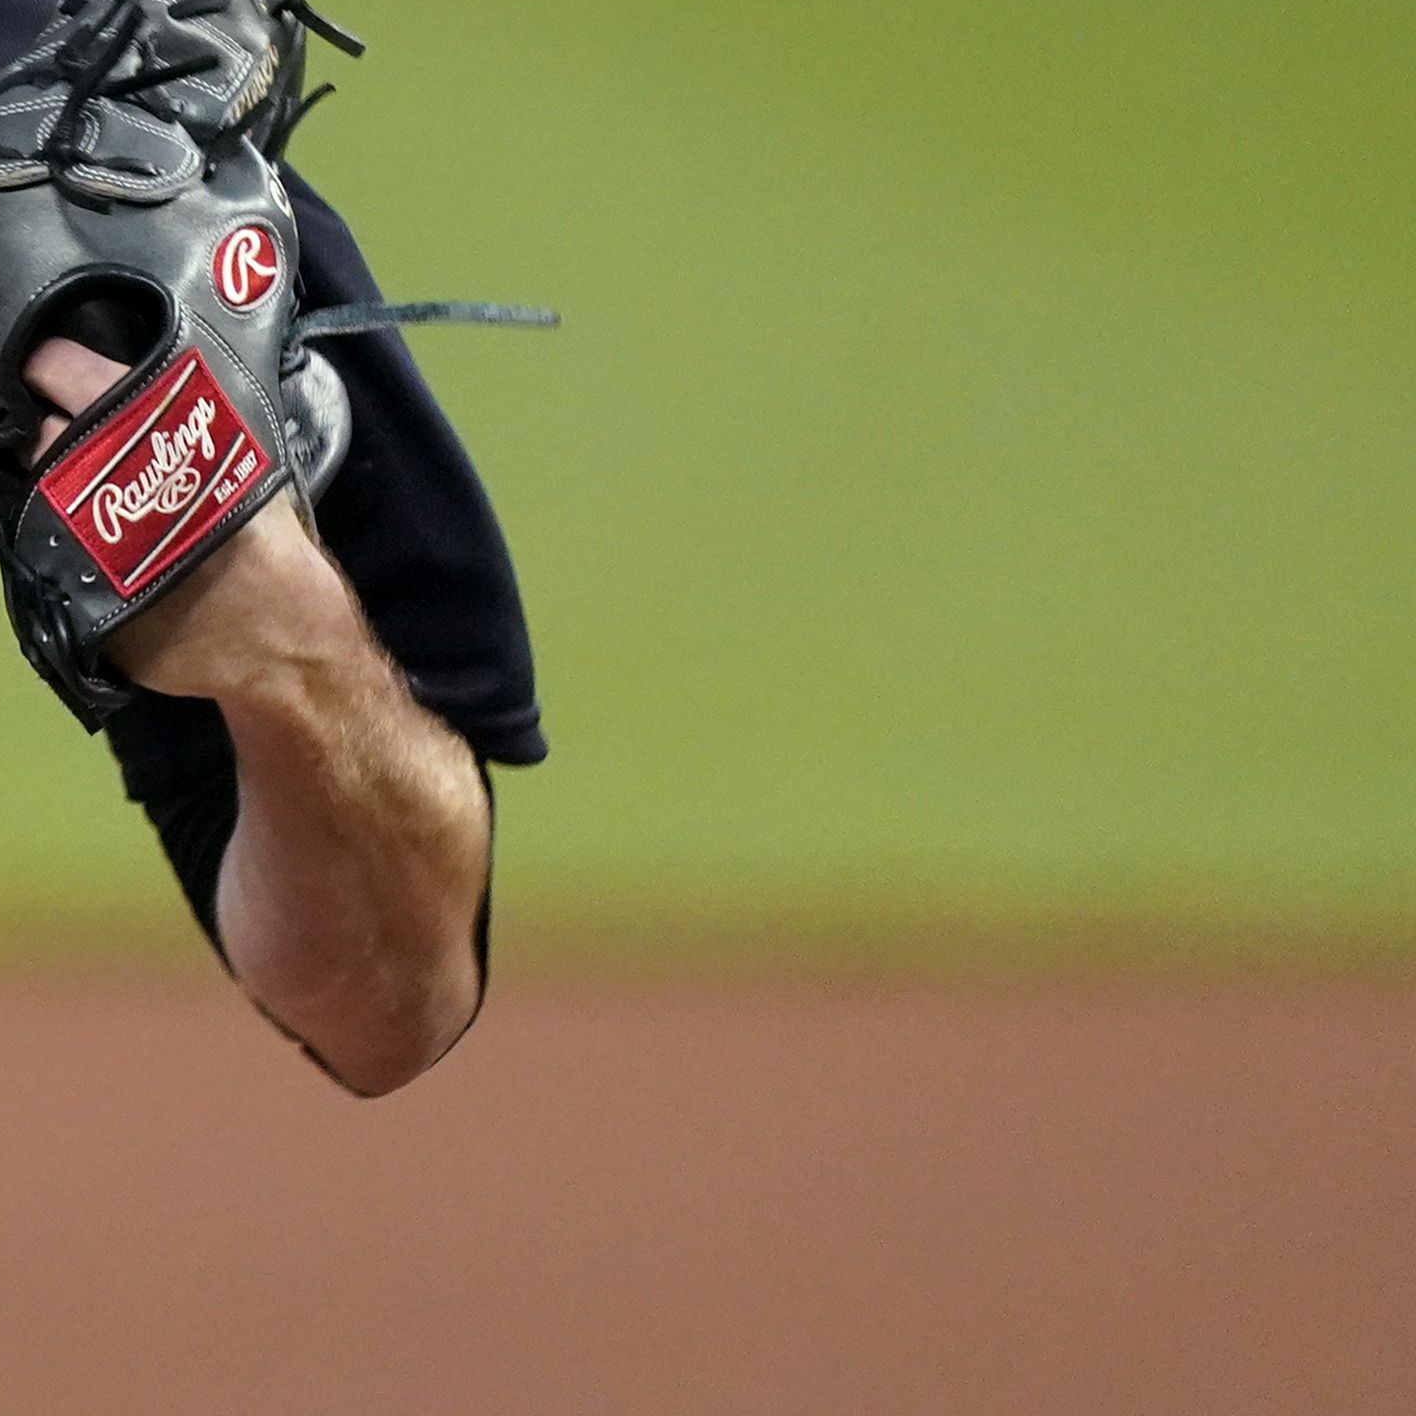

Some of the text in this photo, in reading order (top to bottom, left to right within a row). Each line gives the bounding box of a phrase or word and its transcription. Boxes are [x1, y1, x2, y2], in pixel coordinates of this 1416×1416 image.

[221, 228, 278, 304] R
[91, 396, 217, 545] Rawlings
[213, 477, 239, 505] Est.
